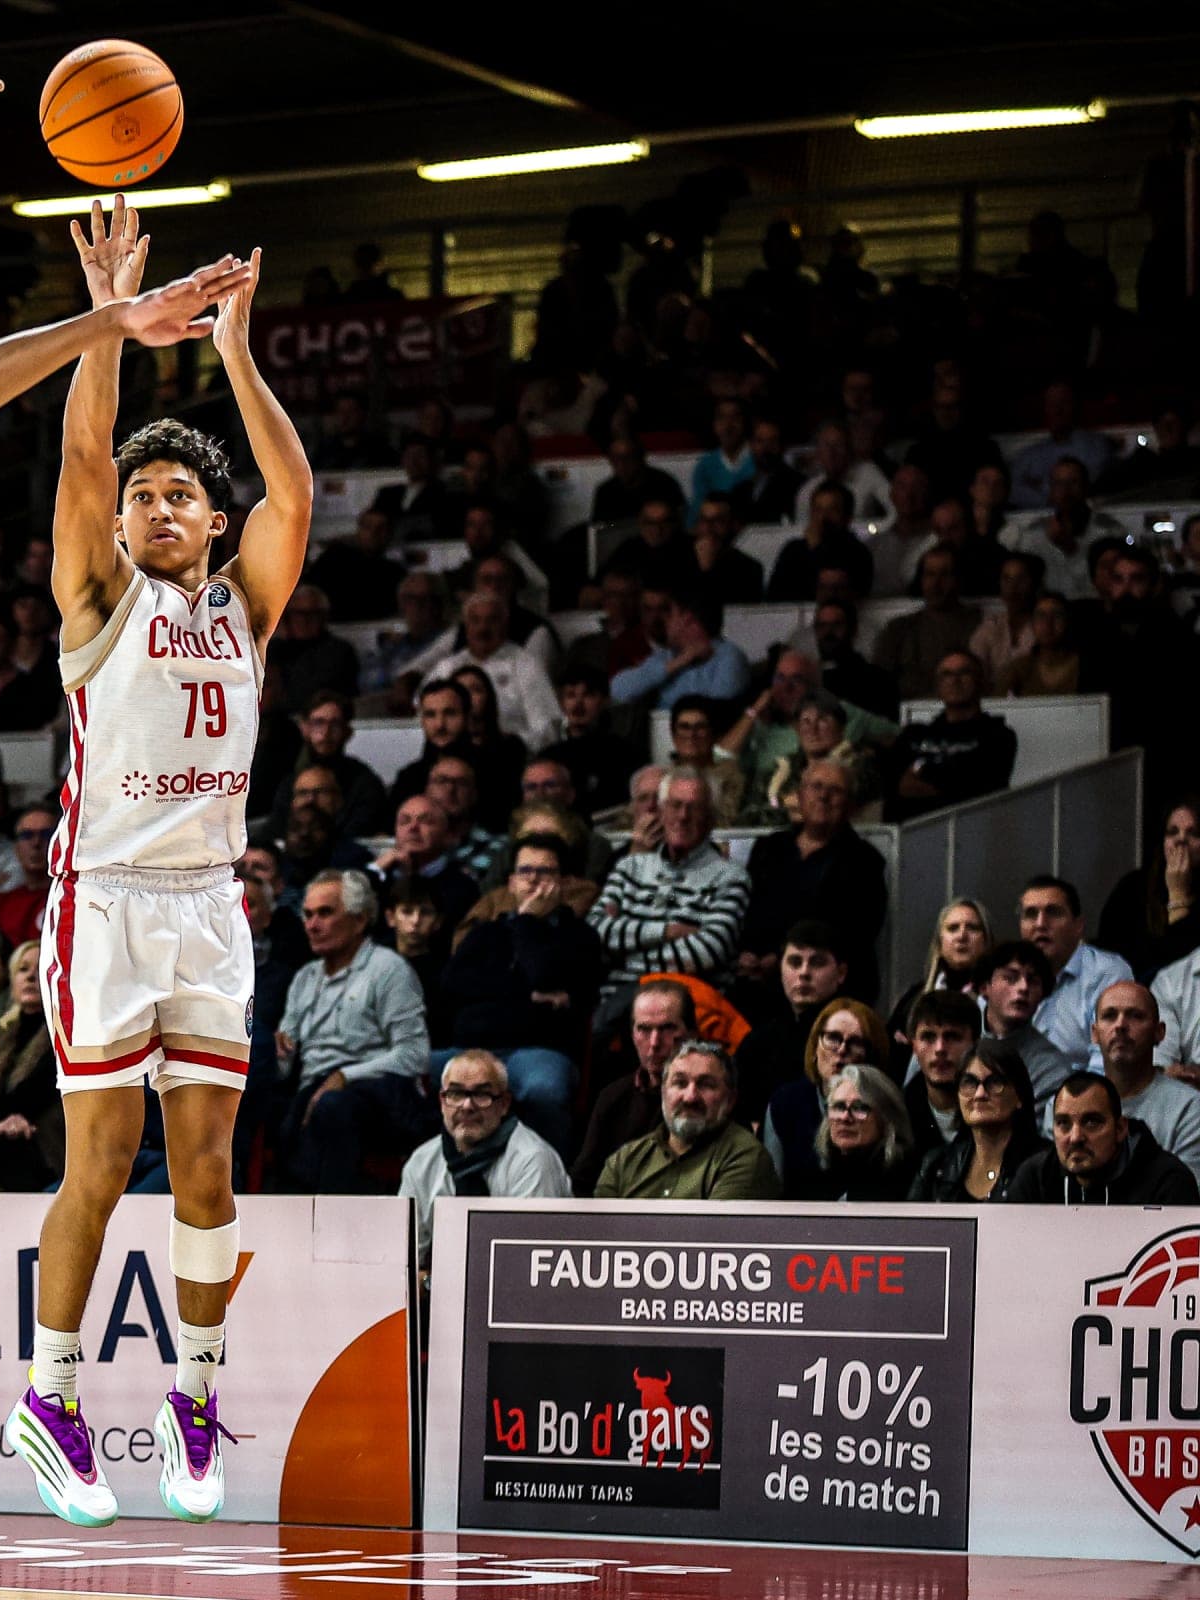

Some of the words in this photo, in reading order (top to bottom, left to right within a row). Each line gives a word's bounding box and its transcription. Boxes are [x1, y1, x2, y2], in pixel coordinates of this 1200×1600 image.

[148, 614, 243, 661] CHOLET
[181, 681, 228, 738] 79
[530, 1249, 772, 1292] FAUBOURG
[785, 1254, 906, 1295] CAFE
[621, 1299, 667, 1321] BAR
[673, 1300, 805, 1324] BRASSERIE
[777, 1356, 933, 1429] -10%
[769, 1419, 823, 1460] les
[835, 1430, 932, 1472] soirs
[495, 1481, 585, 1500] RESTAURANT
[590, 1484, 634, 1502] TAPAS
[764, 1463, 810, 1503] de
[822, 1476, 941, 1518] match
